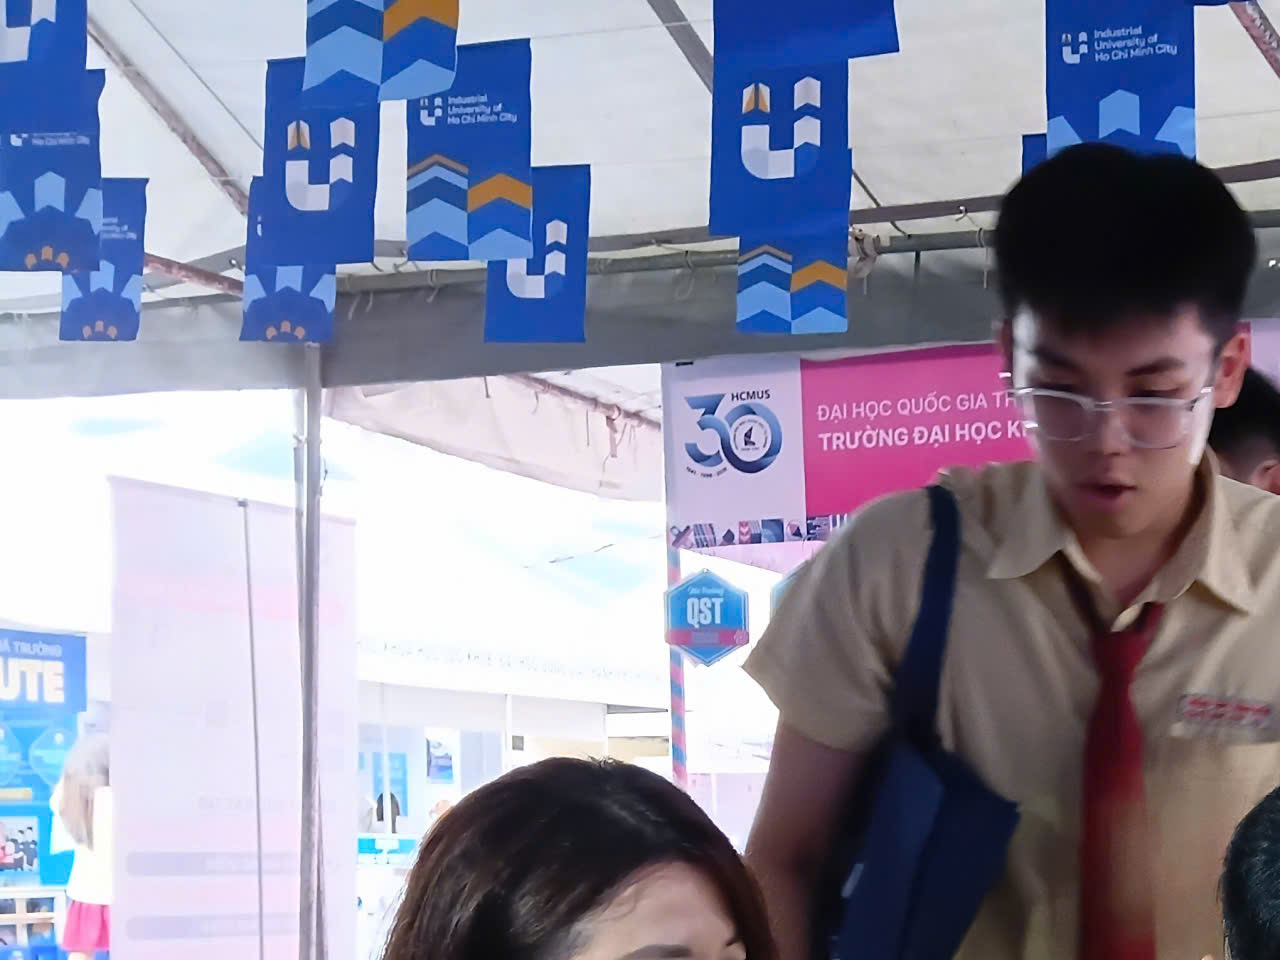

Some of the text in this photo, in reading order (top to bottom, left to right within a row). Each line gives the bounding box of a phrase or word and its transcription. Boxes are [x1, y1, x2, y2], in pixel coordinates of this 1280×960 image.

[1094, 25, 1142, 39] Industrial
[1094, 33, 1158, 50] University of
[1095, 43, 1178, 62] Ho Chi Minh City
[447, 93, 488, 104] Industrial
[447, 103, 503, 115] University of
[447, 111, 518, 125] Ho Chi Minh City
[731, 389, 771, 402] HCMUS
[817, 403, 847, 424] ĐẠI
[852, 400, 892, 420] HỌC
[897, 391, 951, 417] QUỐC
[956, 392, 988, 411] GIA
[818, 425, 909, 451] TRƯỜNG
[912, 423, 950, 449] ĐẠI
[955, 420, 1002, 444] HỌC
[686, 597, 725, 629] QST
